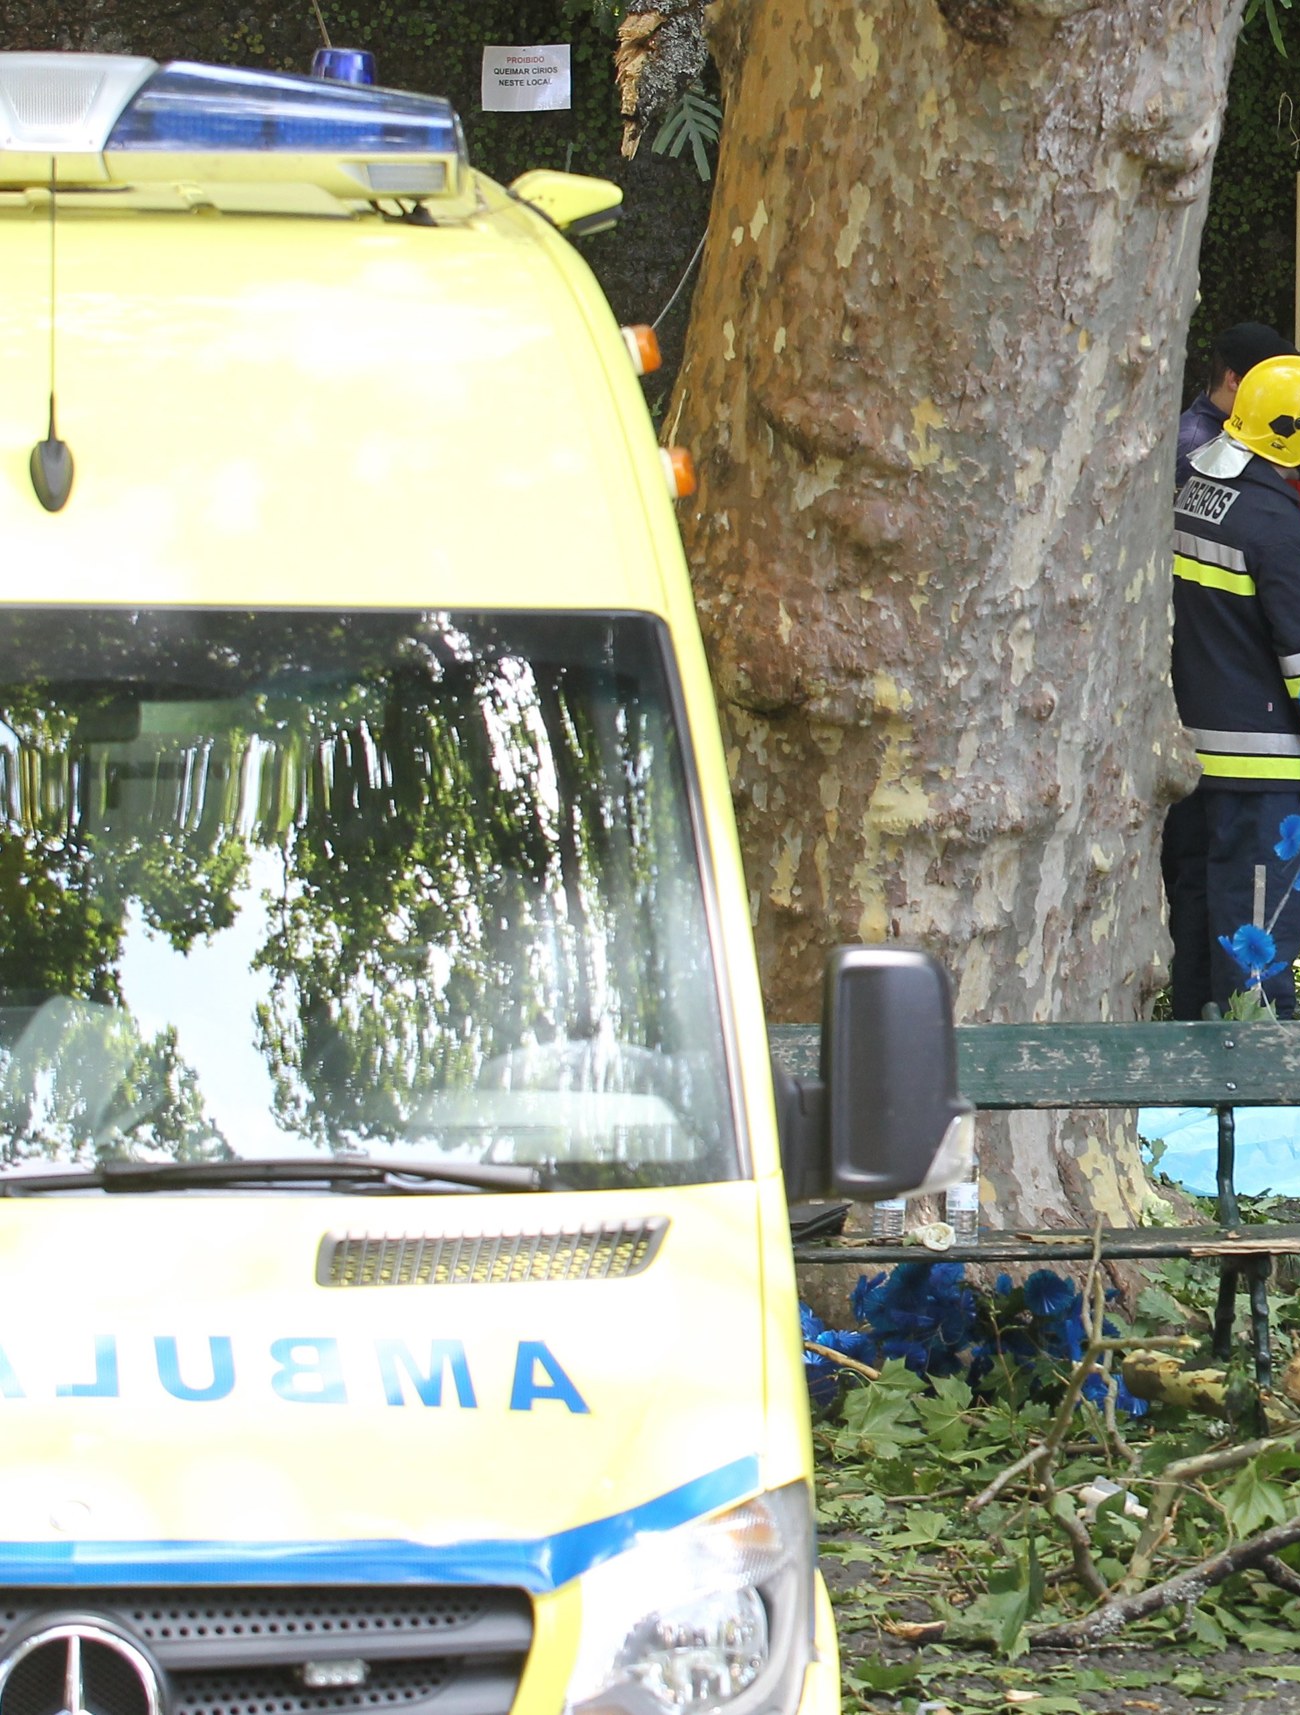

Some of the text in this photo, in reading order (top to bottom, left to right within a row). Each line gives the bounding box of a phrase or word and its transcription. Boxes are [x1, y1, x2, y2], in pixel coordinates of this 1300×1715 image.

[506, 56, 545, 64] PROIBIDO
[493, 66, 558, 75] QUEIMAR CÍRIOS
[498, 78, 552, 87] NESTE LOCAL
